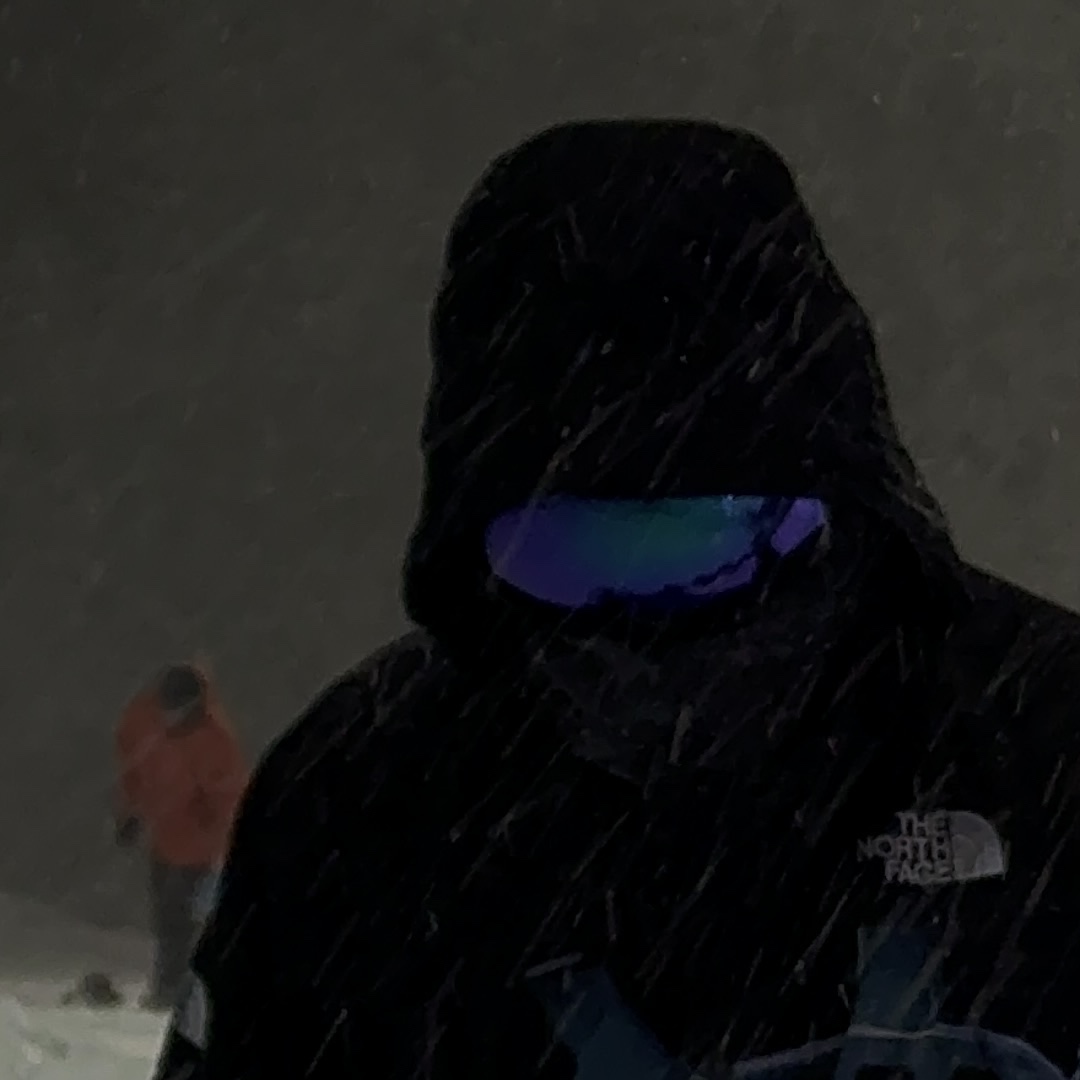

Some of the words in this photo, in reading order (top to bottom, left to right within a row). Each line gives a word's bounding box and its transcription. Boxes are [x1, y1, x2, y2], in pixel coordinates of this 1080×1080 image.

[895, 809, 949, 836] THE
[856, 834, 950, 863] NORTH
[885, 860, 953, 886] FACE
